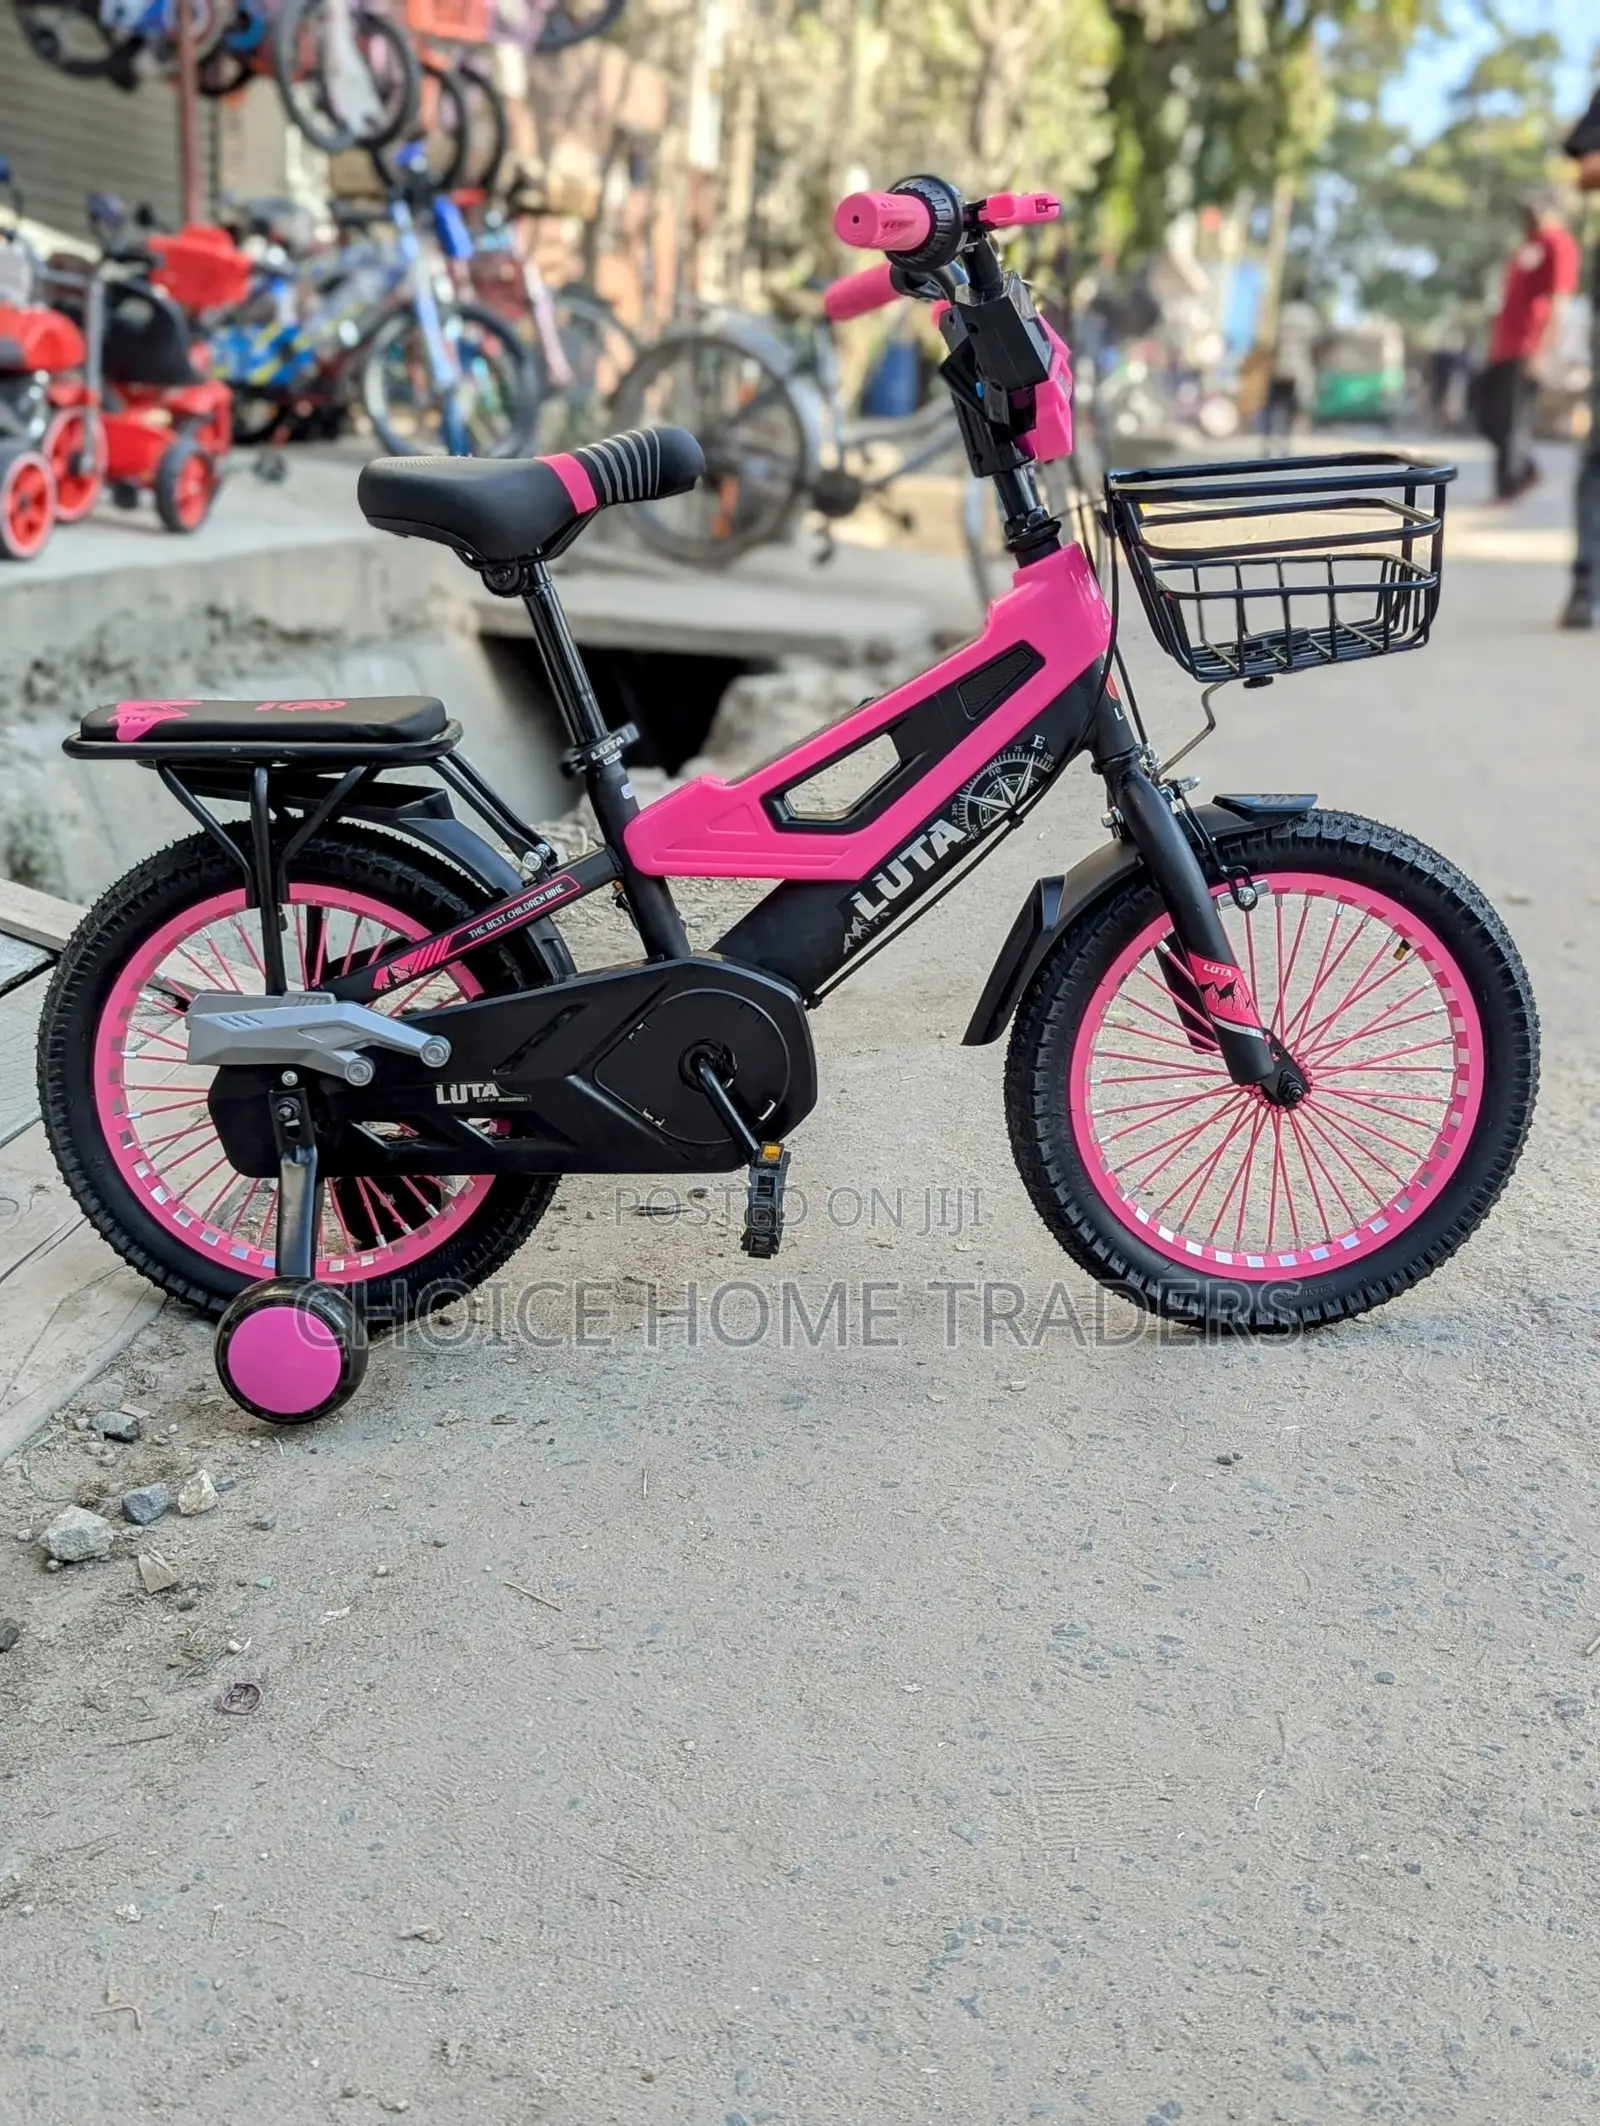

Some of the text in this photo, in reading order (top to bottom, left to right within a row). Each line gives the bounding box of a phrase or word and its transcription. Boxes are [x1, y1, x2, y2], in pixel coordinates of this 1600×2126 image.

[591, 736, 625, 760] LUTA
[1030, 734, 1046, 750] E
[850, 819, 967, 921] LUTA
[468, 884, 565, 938] THE BEST CHILDREN BIKE
[1203, 963, 1232, 977] LUTA
[436, 1083, 500, 1104] LUTA
